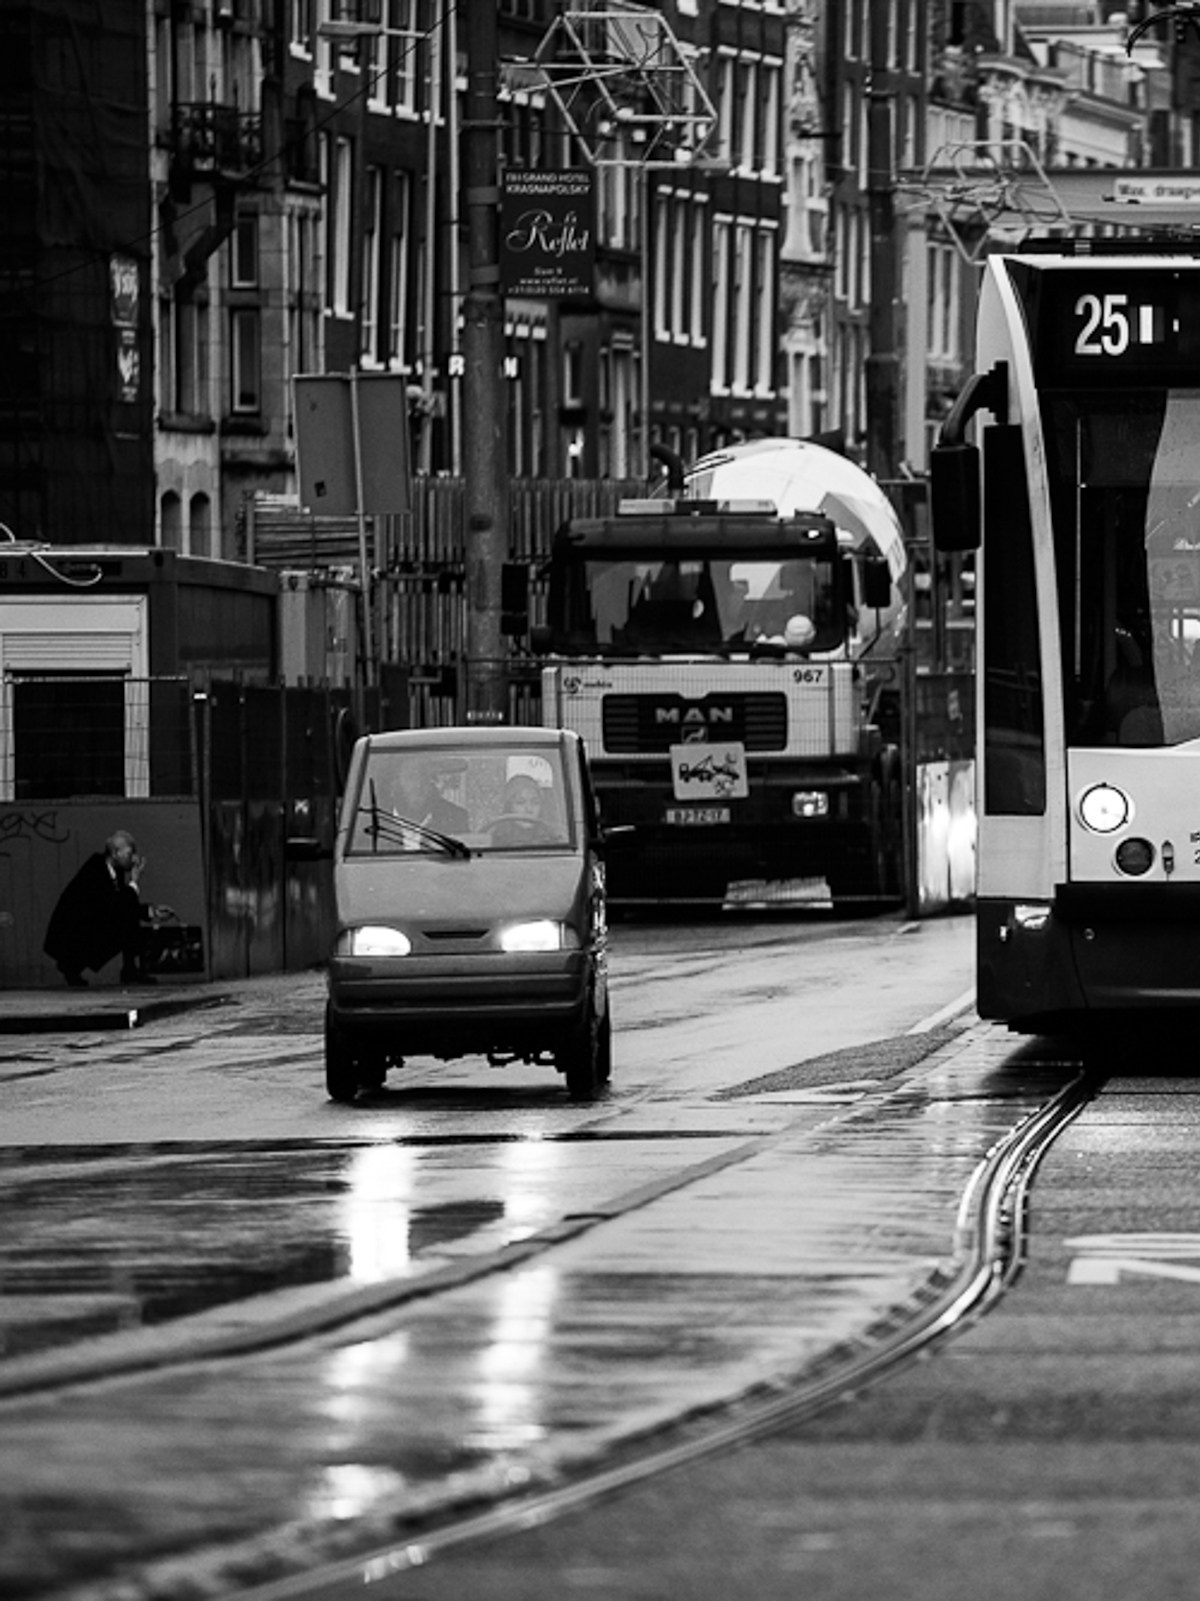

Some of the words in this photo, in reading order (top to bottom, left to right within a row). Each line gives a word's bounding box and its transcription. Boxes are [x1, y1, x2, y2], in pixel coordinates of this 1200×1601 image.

[506, 184, 590, 195] KRASNAPOLSKY
[505, 209, 589, 258] Reflet
[1075, 294, 1129, 356] 25
[793, 669, 823, 683] 967
[655, 707, 733, 723] MAN
